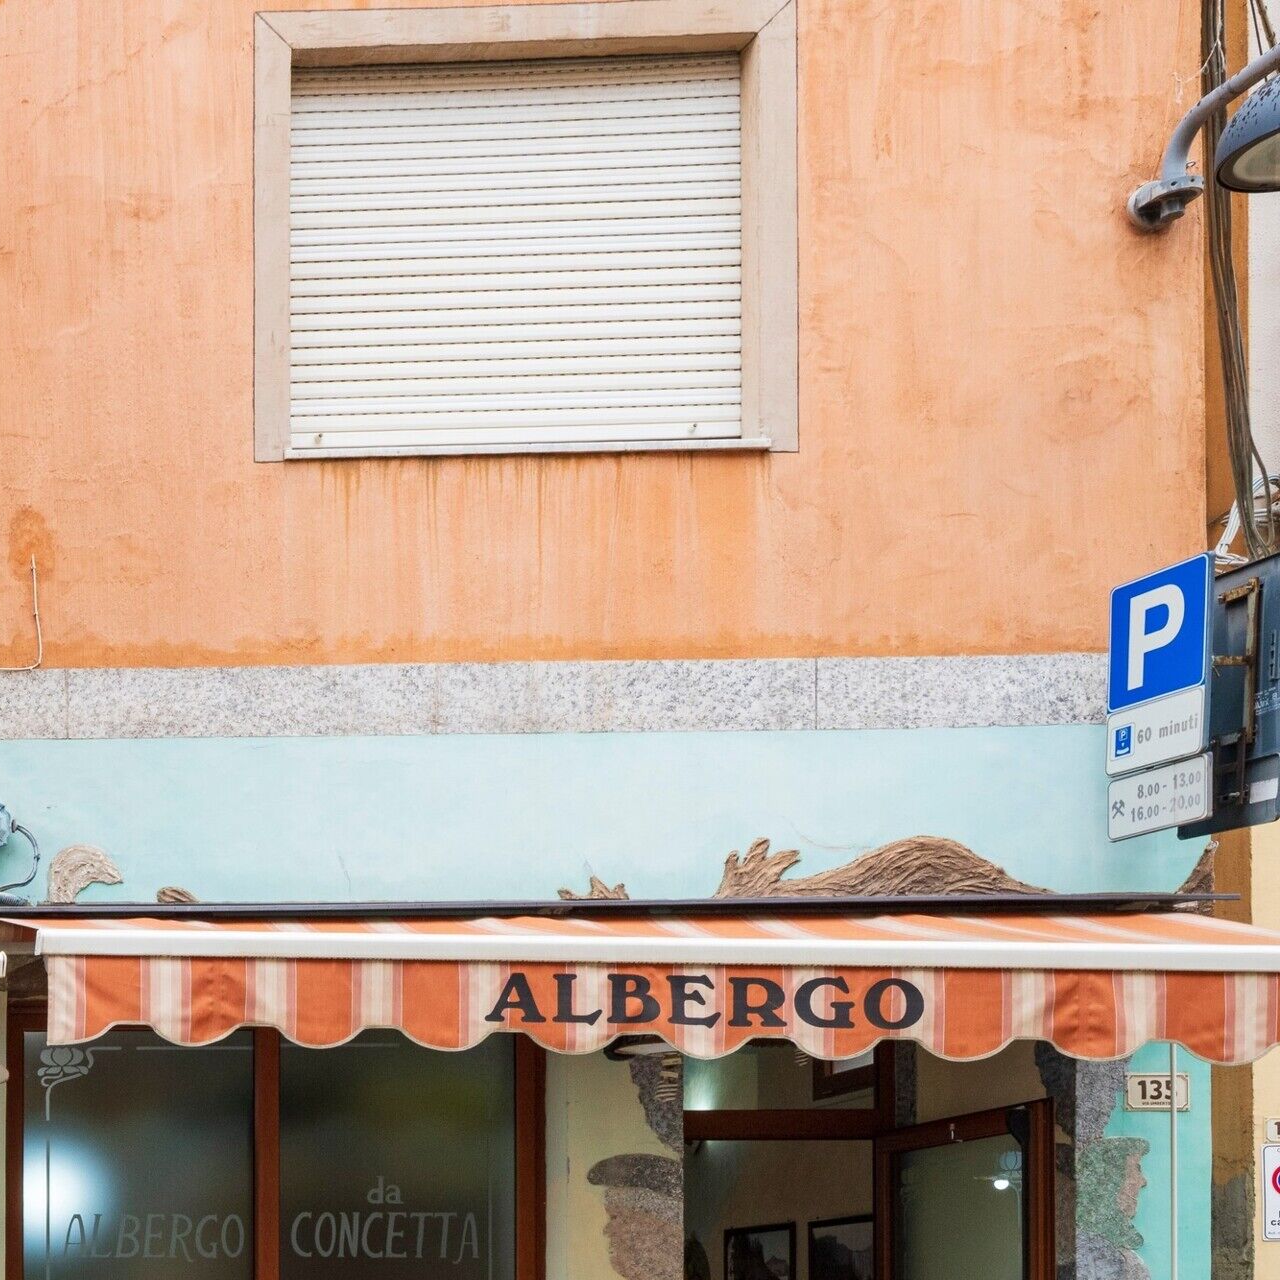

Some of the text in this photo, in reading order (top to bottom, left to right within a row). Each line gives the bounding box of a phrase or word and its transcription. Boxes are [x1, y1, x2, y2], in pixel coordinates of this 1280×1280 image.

[1127, 584, 1185, 691] P
[1137, 714, 1198, 744] 60 minuti
[1137, 782, 1160, 799] 8.00
[1173, 771, 1200, 789] 13.00
[1131, 805, 1159, 822] 16.00
[1170, 794, 1200, 813] 20.00
[484, 972, 925, 1029] ALBERGO
[367, 1176, 404, 1204] da
[64, 1211, 480, 1264] ALBERGO CONCETTA
